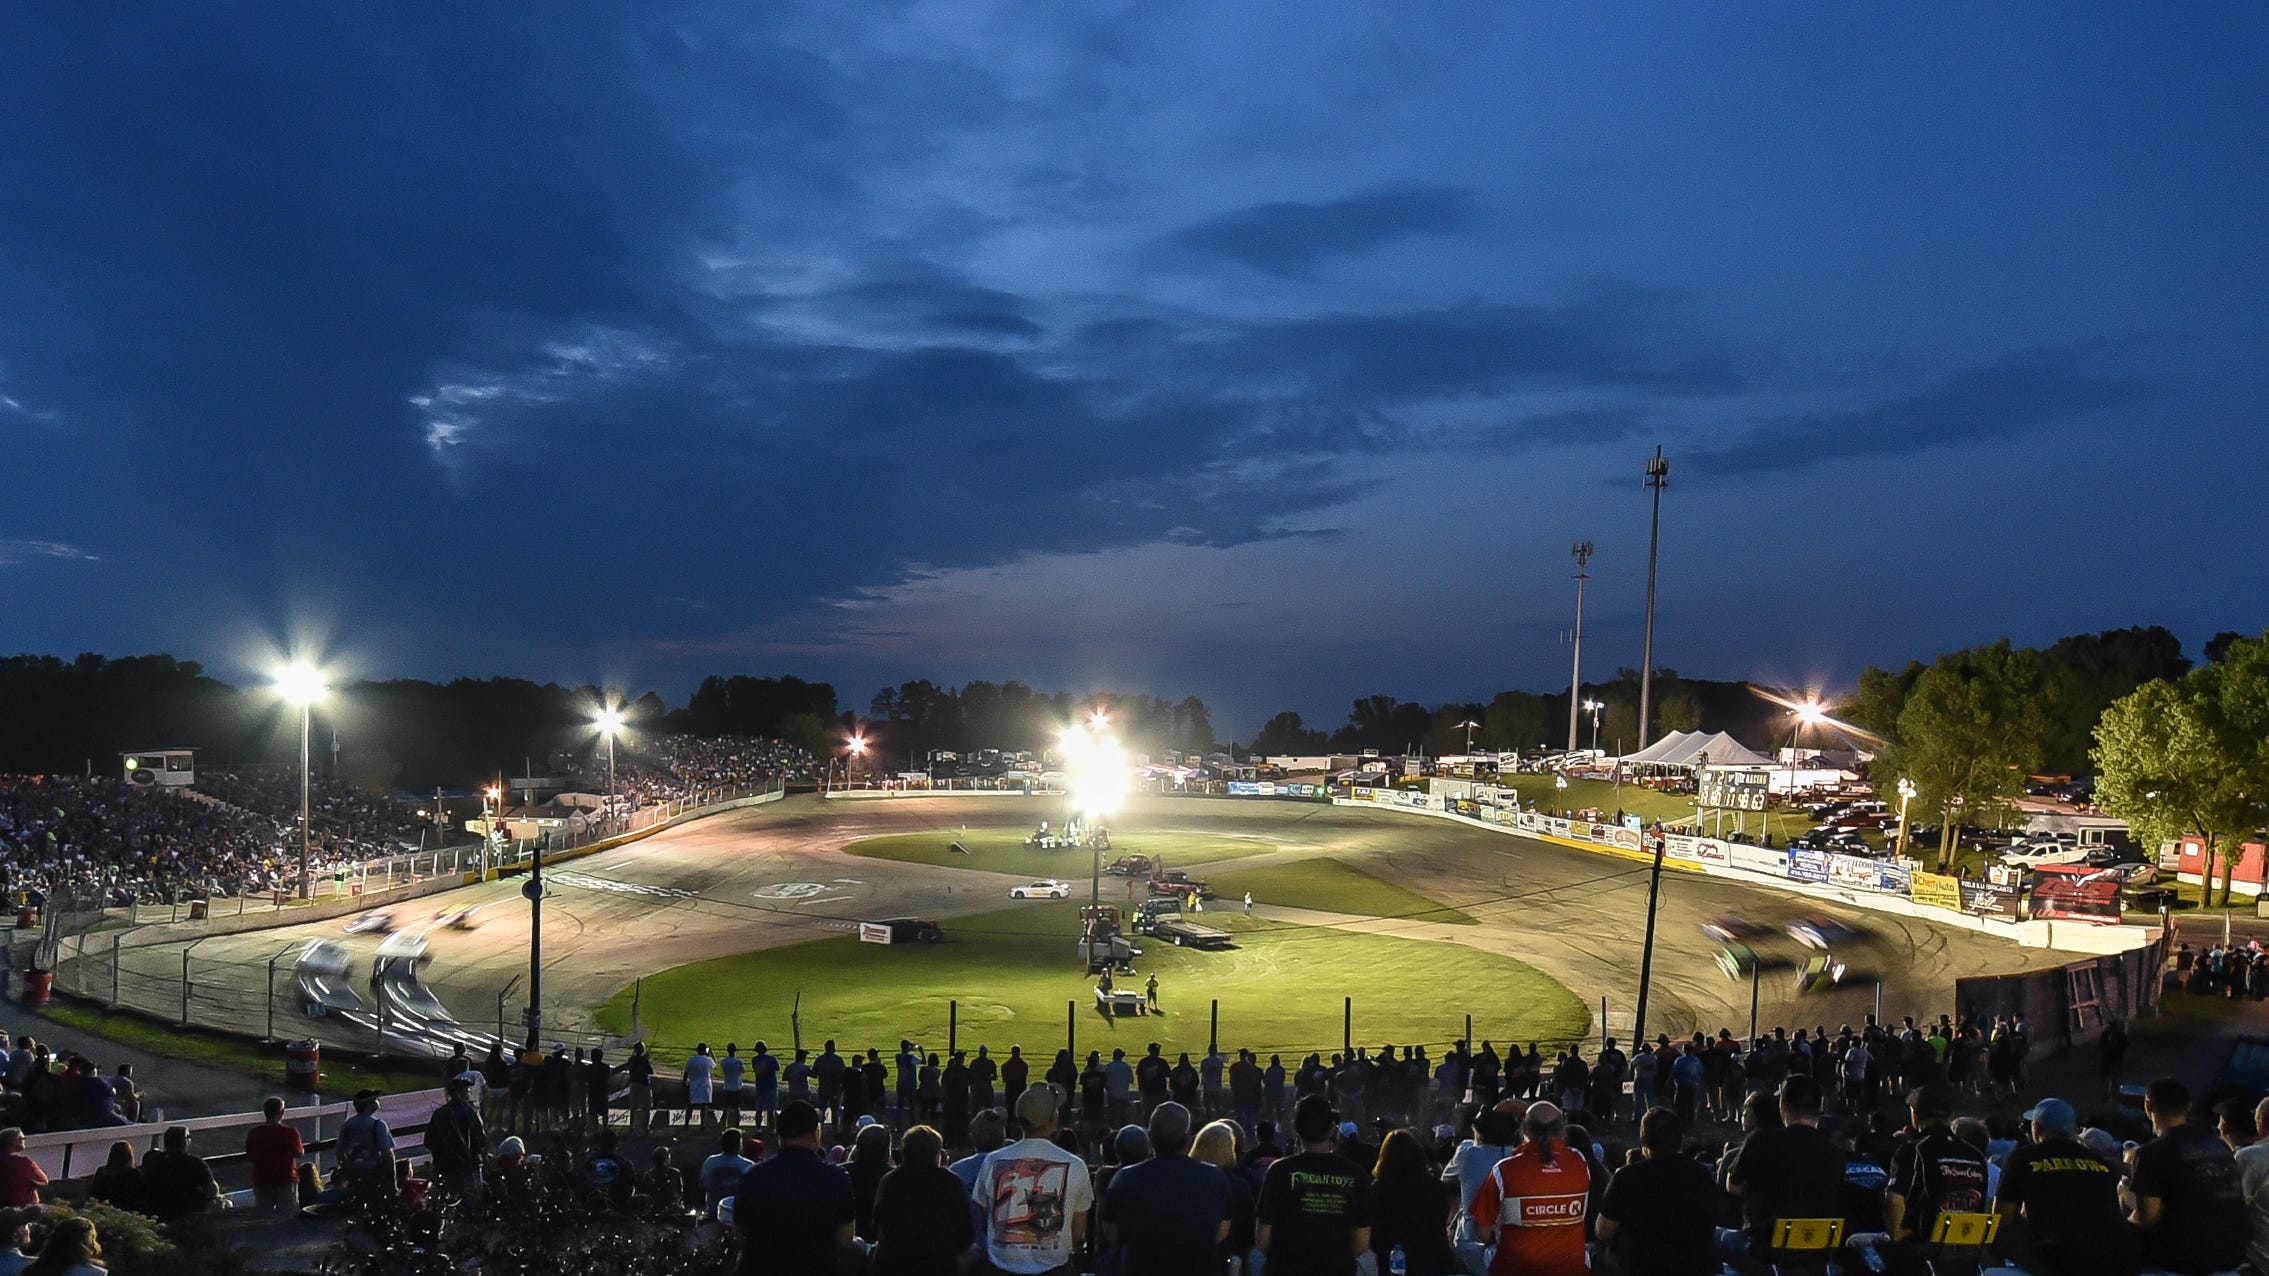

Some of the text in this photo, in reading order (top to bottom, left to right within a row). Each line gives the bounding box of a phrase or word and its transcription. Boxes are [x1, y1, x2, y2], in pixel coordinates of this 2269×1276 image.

[1746, 774, 1767, 784] RACING
[1526, 1202, 1580, 1216] CIRCLE K
